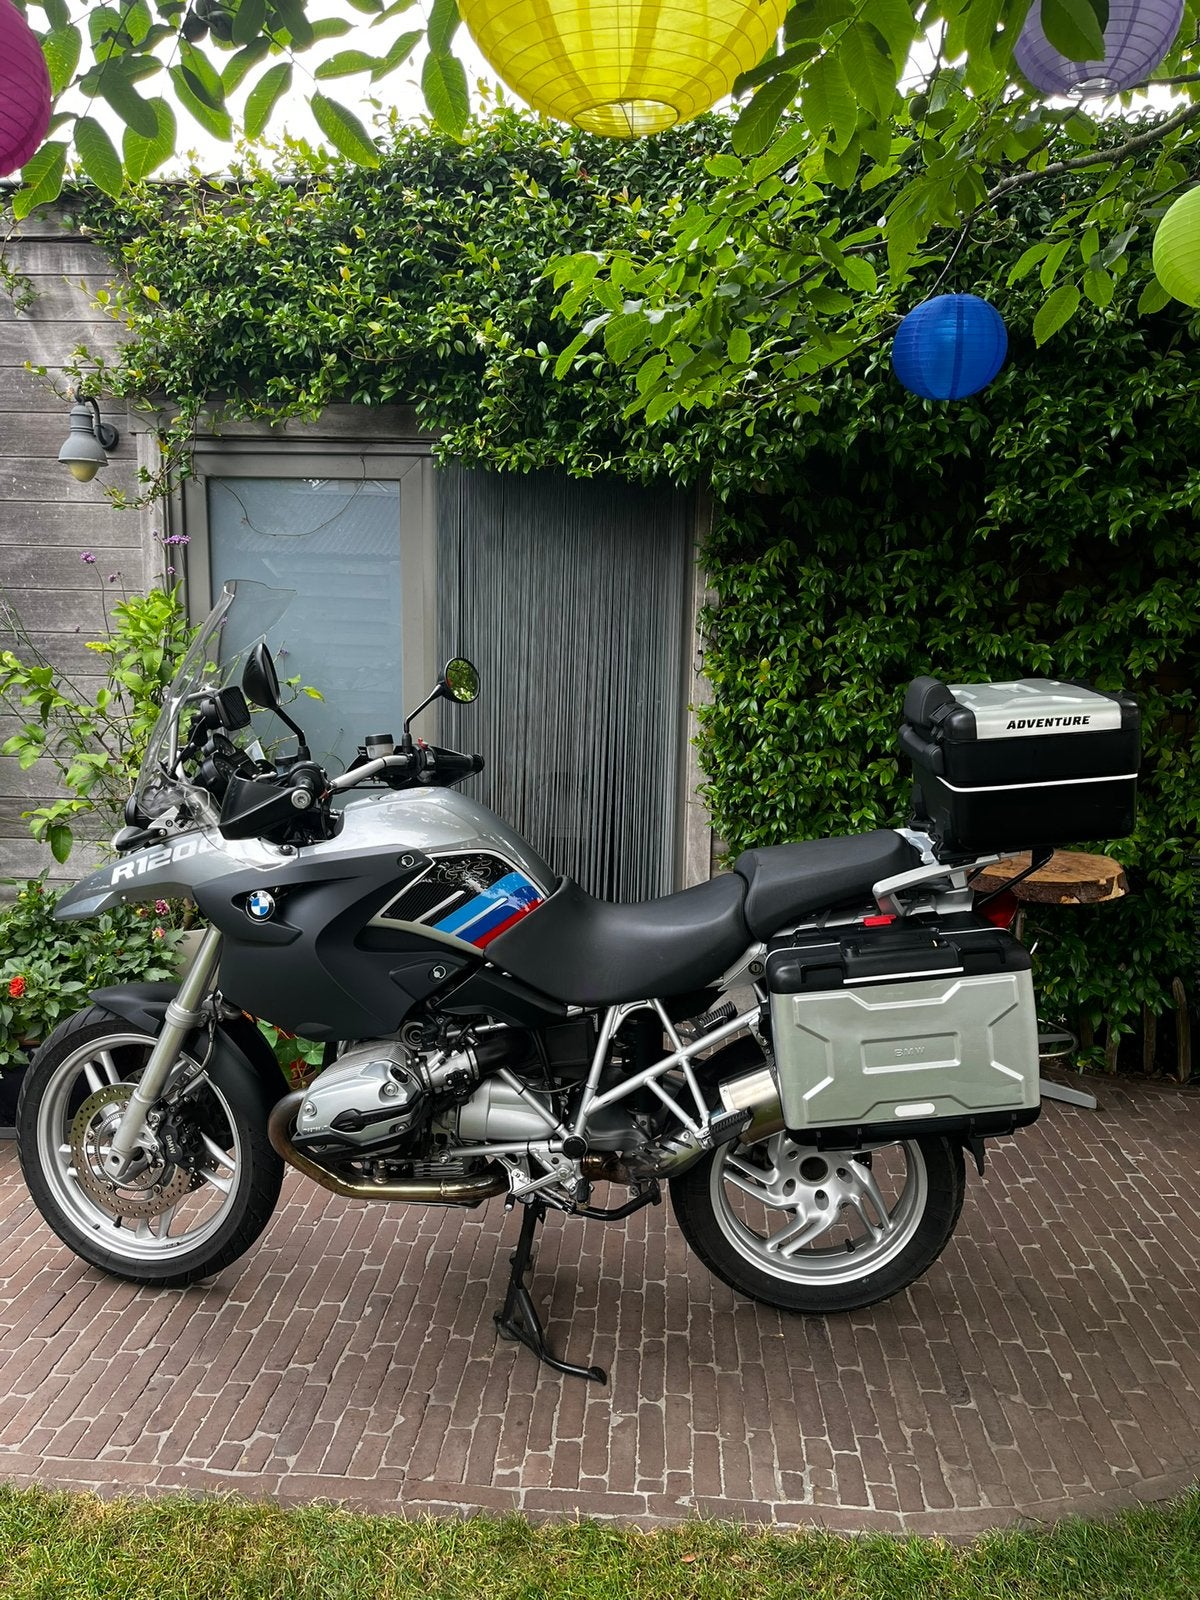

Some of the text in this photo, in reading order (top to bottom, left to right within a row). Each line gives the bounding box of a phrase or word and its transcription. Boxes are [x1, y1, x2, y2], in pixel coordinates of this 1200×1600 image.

[1006, 715, 1091, 730] ADVENTURE
[894, 1046, 925, 1058] BMW
[165, 1134, 177, 1154] BMW
